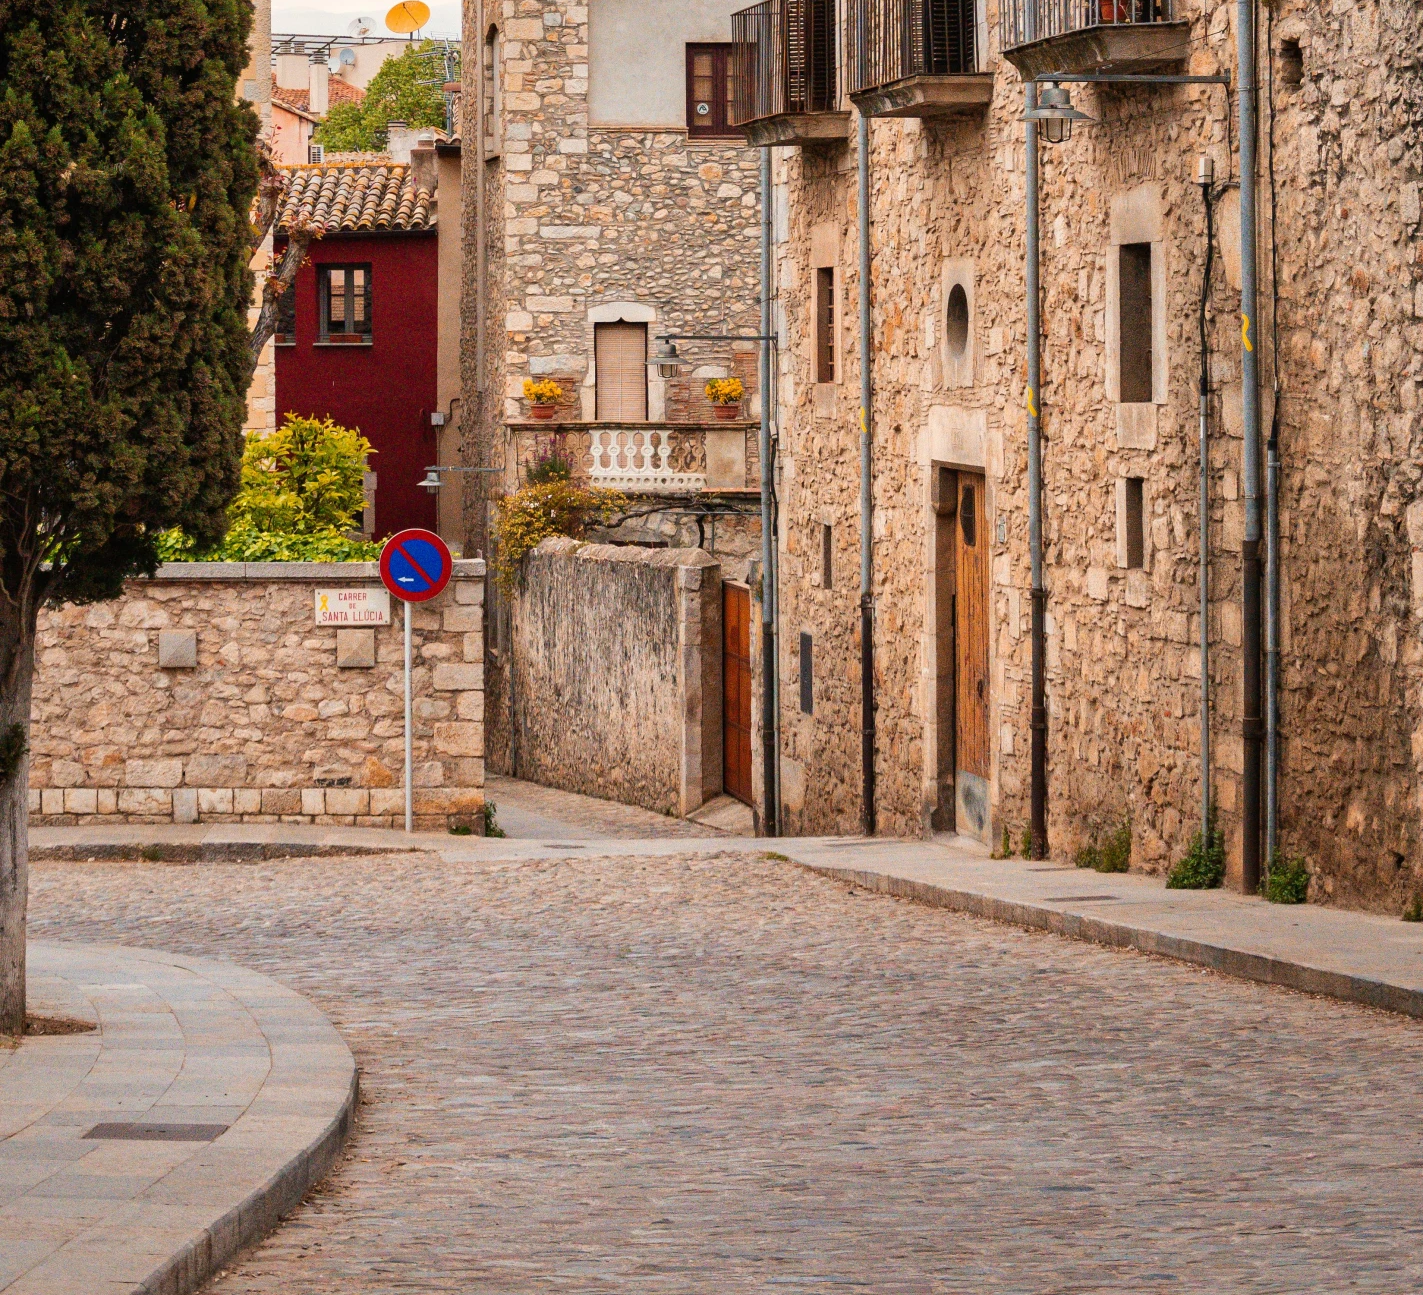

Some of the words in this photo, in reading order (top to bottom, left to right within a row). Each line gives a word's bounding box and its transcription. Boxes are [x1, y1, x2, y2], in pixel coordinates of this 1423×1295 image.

[338, 592, 367, 601] CARRER
[322, 611, 348, 621] SANTA
[353, 609, 383, 621] LLÚCIA
